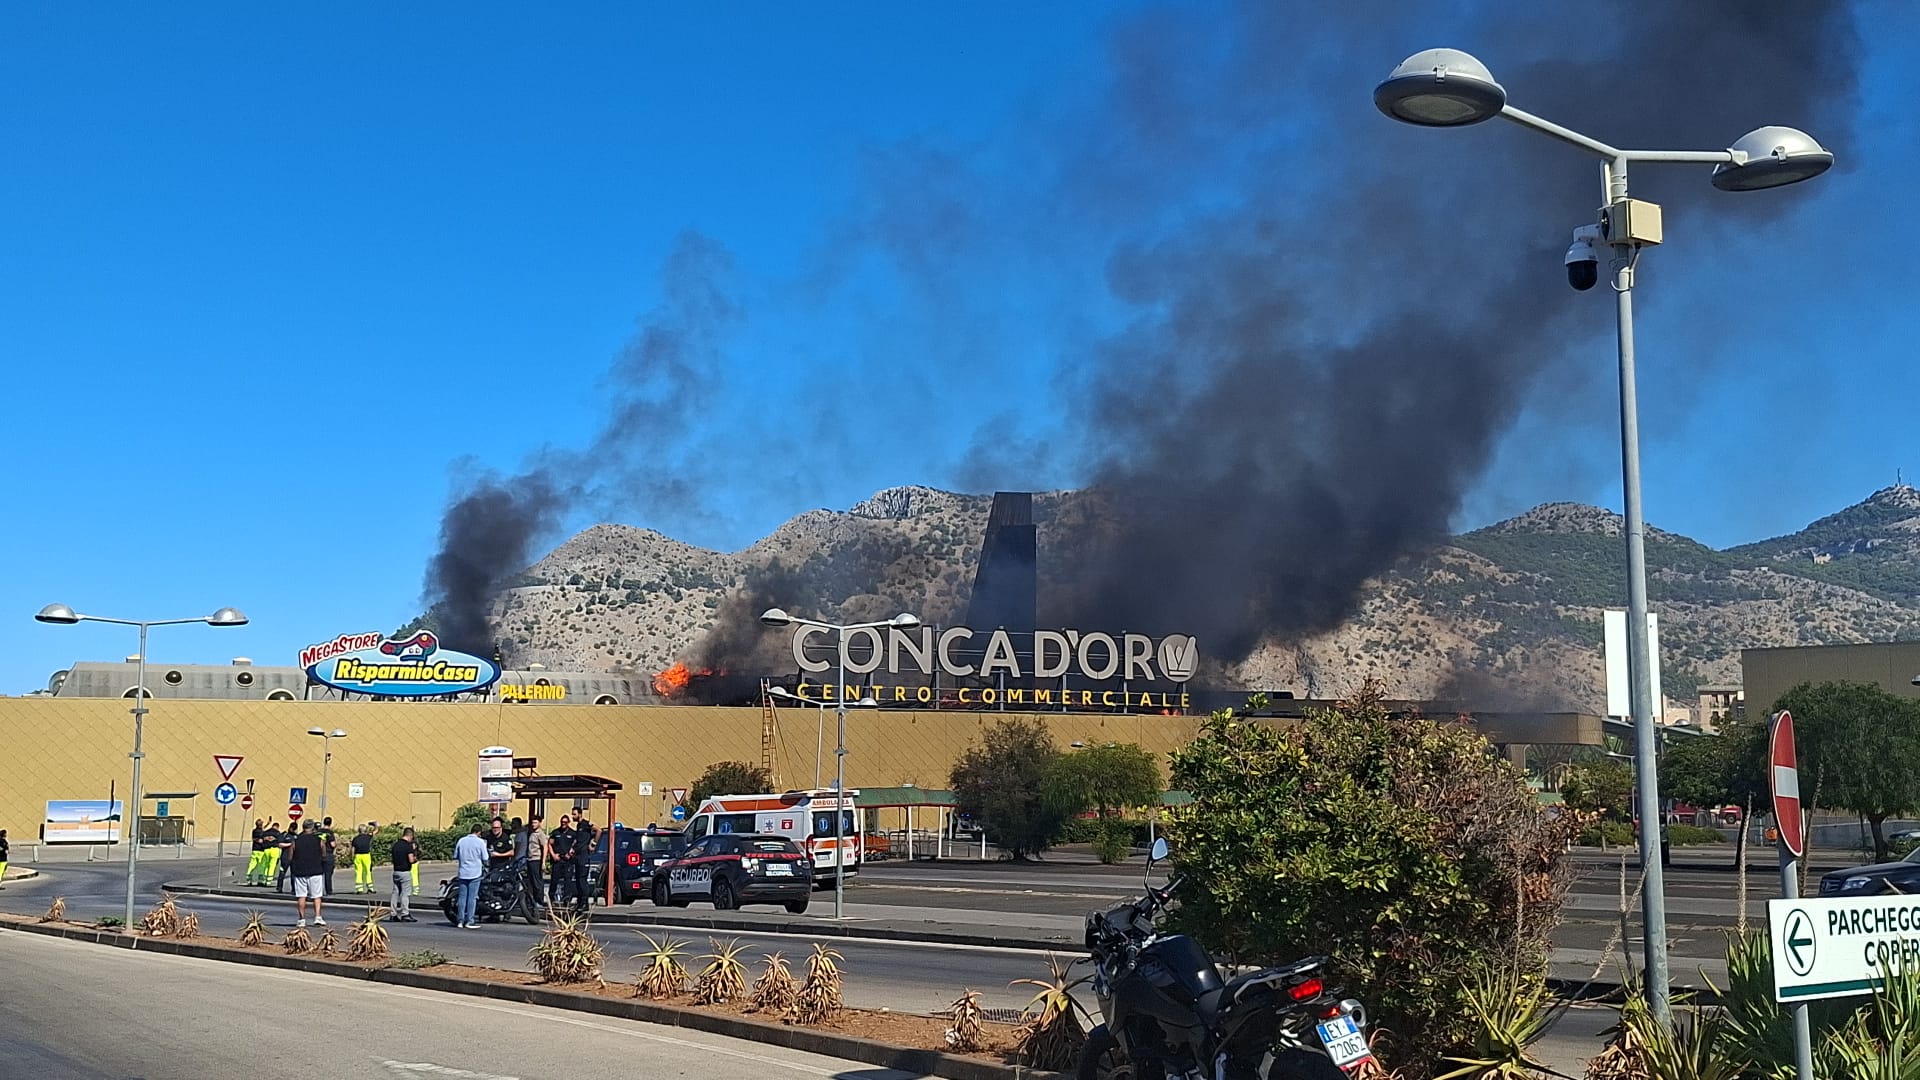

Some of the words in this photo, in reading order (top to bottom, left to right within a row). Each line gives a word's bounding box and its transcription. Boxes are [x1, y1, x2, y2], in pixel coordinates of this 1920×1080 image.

[792, 624, 1021, 678] CONCA
[335, 659, 478, 683] RisparmioCasa
[499, 684, 566, 700] PALERMO
[797, 683, 932, 703] CENTRO
[958, 687, 1191, 708] COMMERCIALE
[1828, 906, 1920, 936] PARCHEGG
[1326, 1022, 1343, 1039] EY
[1329, 1036, 1366, 1061] 72062
